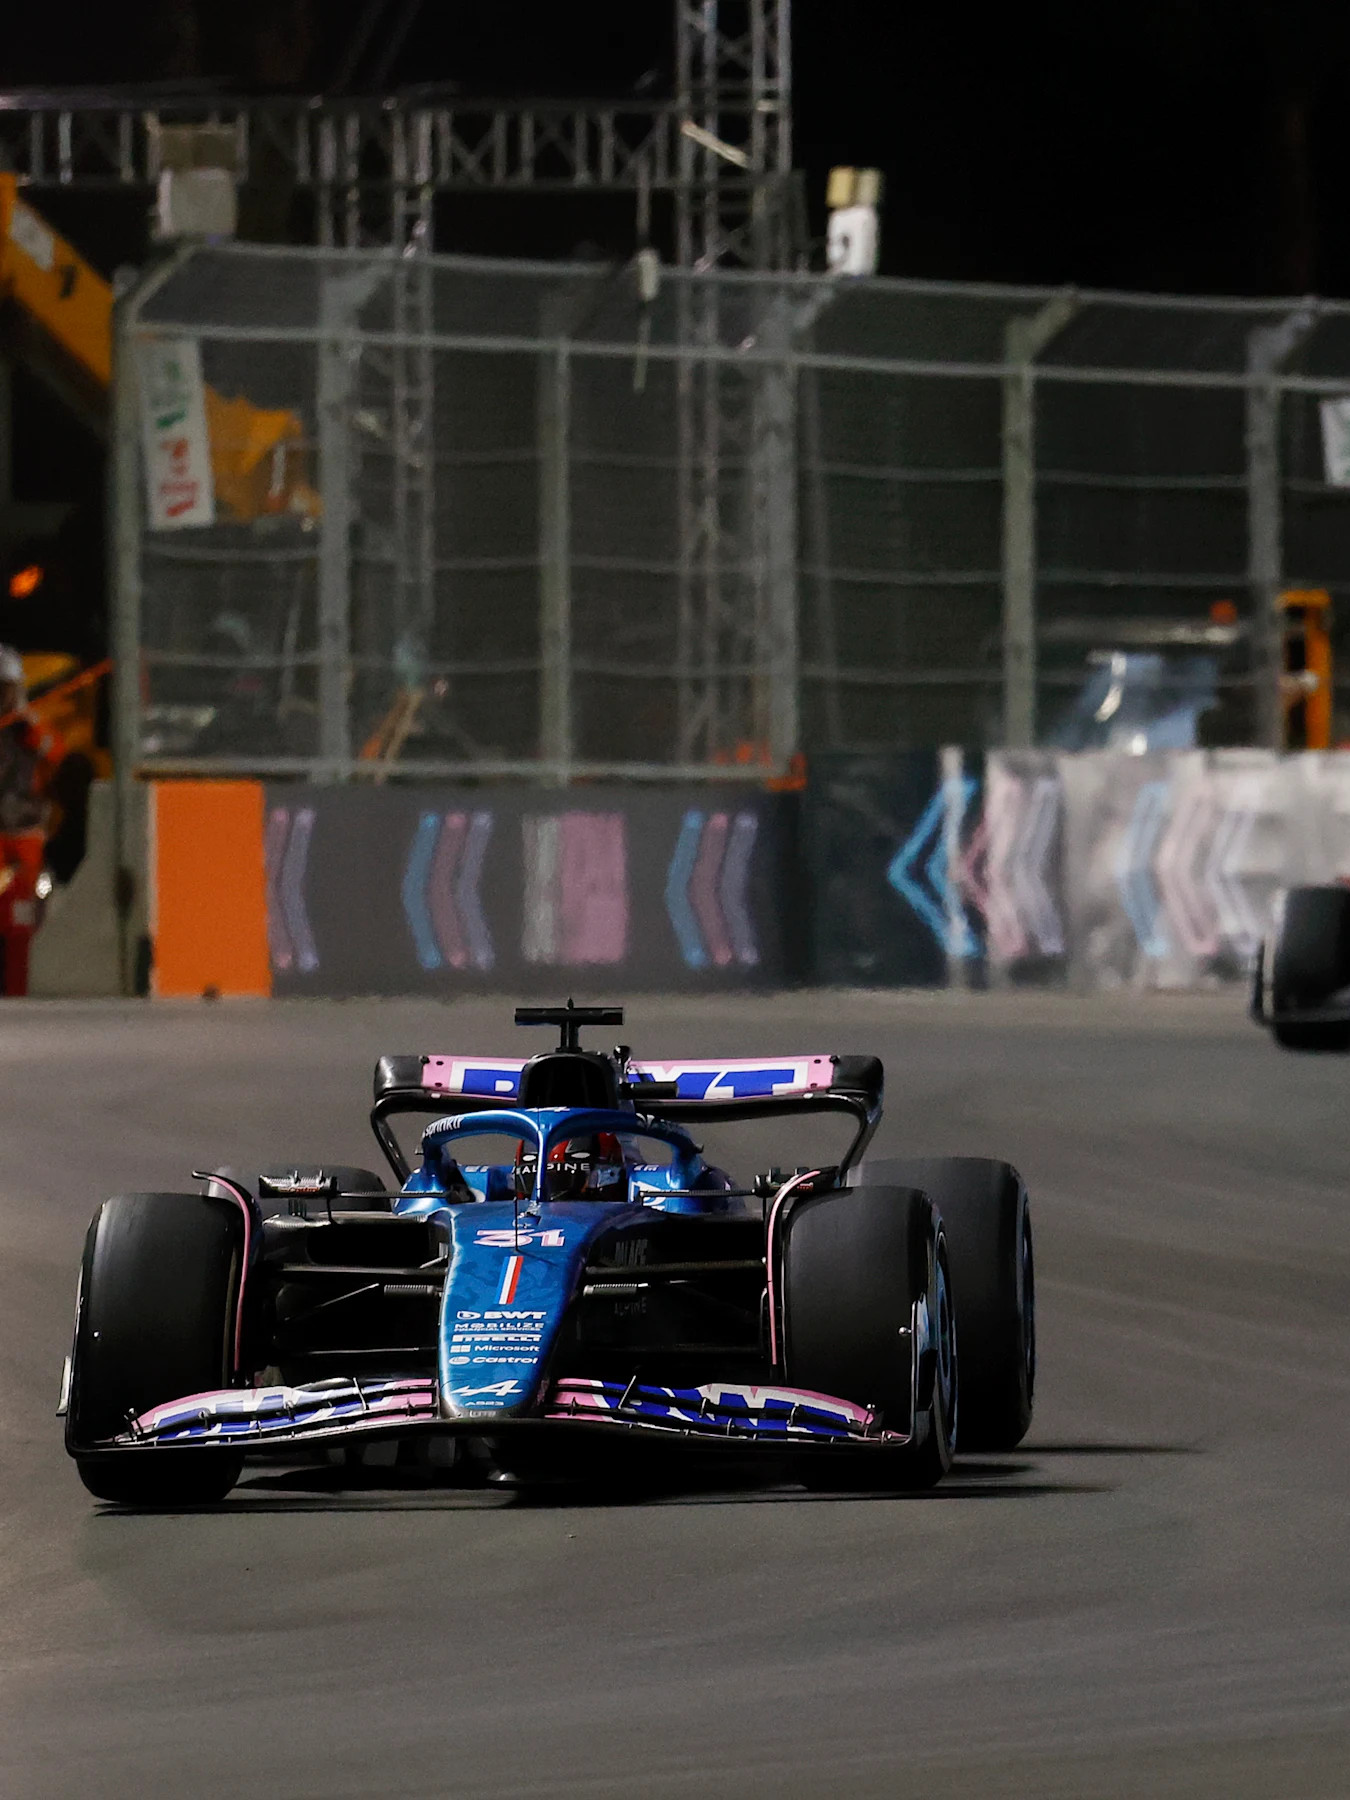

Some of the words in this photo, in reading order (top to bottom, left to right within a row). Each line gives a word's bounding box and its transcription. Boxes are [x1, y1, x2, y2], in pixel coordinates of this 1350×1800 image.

[473, 1228, 565, 1247] 31
[484, 1311, 547, 1320] BWT
[452, 1334, 542, 1342] PIRELLI
[472, 1356, 539, 1364] Castrol
